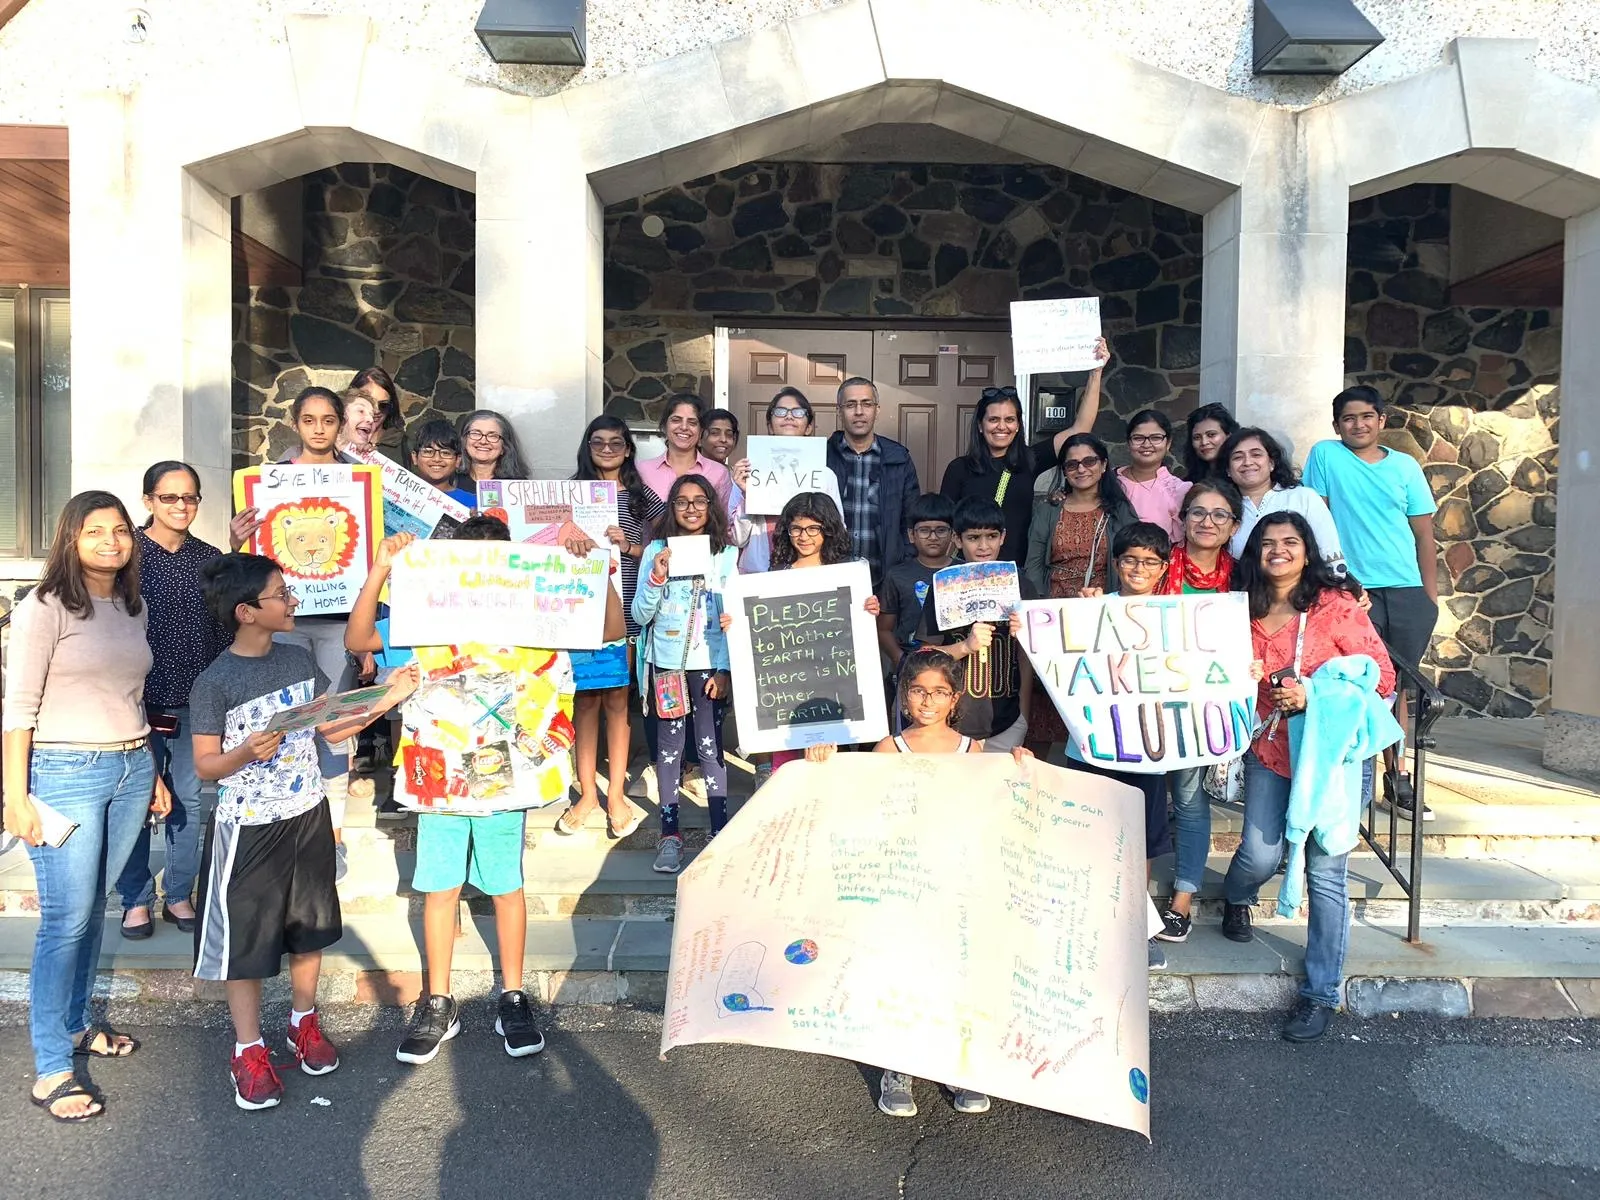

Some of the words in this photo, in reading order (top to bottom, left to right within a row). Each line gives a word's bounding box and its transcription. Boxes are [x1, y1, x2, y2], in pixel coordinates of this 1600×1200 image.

[1047, 407, 1065, 418] 100
[394, 468, 426, 496] PLASTIC
[412, 499, 426, 517] it!
[507, 553, 568, 575] Earth
[570, 558, 605, 576] will
[305, 582, 347, 595] KILLING
[532, 575, 595, 599] Earth,
[314, 596, 348, 608] HOME
[531, 596, 584, 614] NOT
[965, 600, 998, 614] 2050
[753, 598, 838, 625] PLEDGE
[1027, 601, 1217, 654] PLASTIC
[755, 638, 775, 654] to
[780, 629, 844, 650] Mother
[829, 646, 854, 660] for
[758, 669, 807, 687] there
[815, 666, 830, 679] is
[836, 659, 857, 677] No
[760, 690, 815, 708] Other
[776, 693, 843, 722] EARTH!
[1003, 779, 1031, 791] Take
[1036, 787, 1058, 803] your
[1080, 804, 1104, 817] own
[1036, 804, 1046, 818] to
[884, 847, 918, 860] things
[831, 862, 851, 872] we
[859, 861, 881, 870] use
[1079, 981, 1093, 998] too
